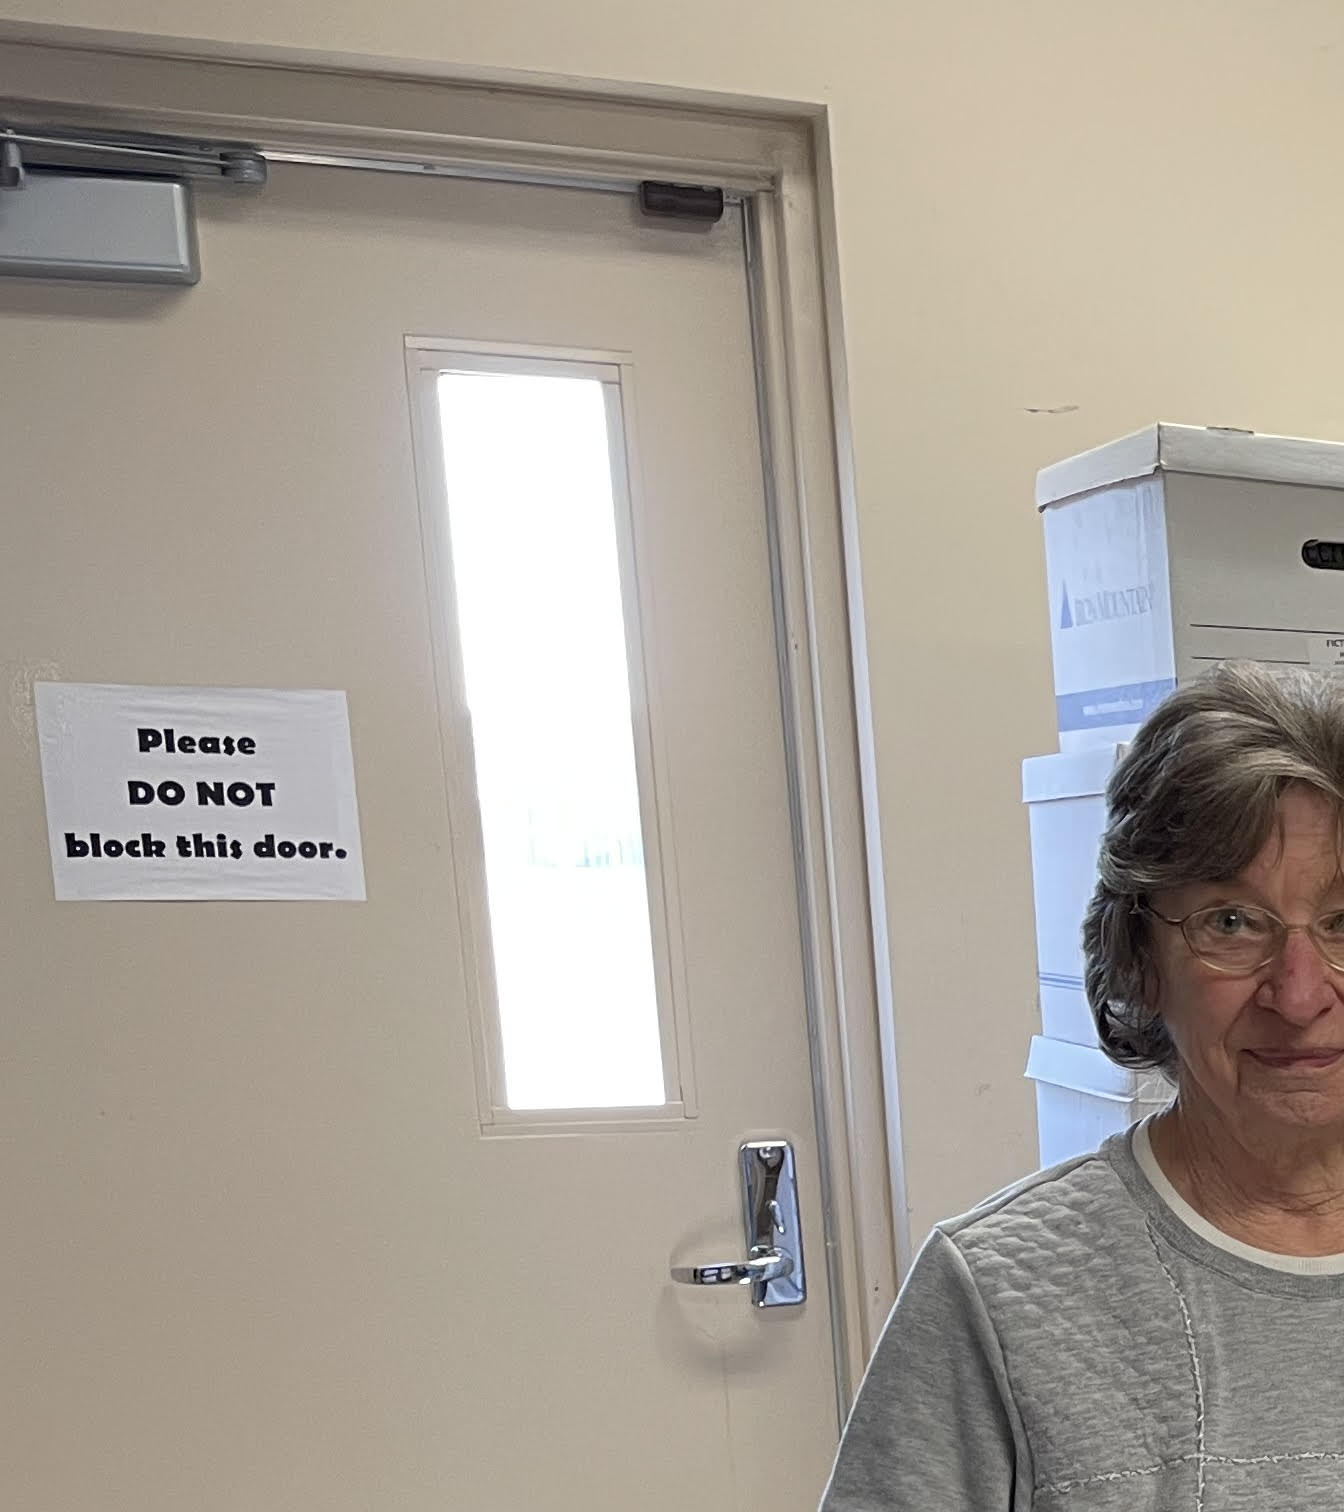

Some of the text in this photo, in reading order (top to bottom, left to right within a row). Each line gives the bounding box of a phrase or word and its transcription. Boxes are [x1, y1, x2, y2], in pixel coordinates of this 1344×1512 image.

[137, 728, 256, 755] Please
[128, 781, 276, 806] DO NOT
[65, 833, 347, 860] block this door.
